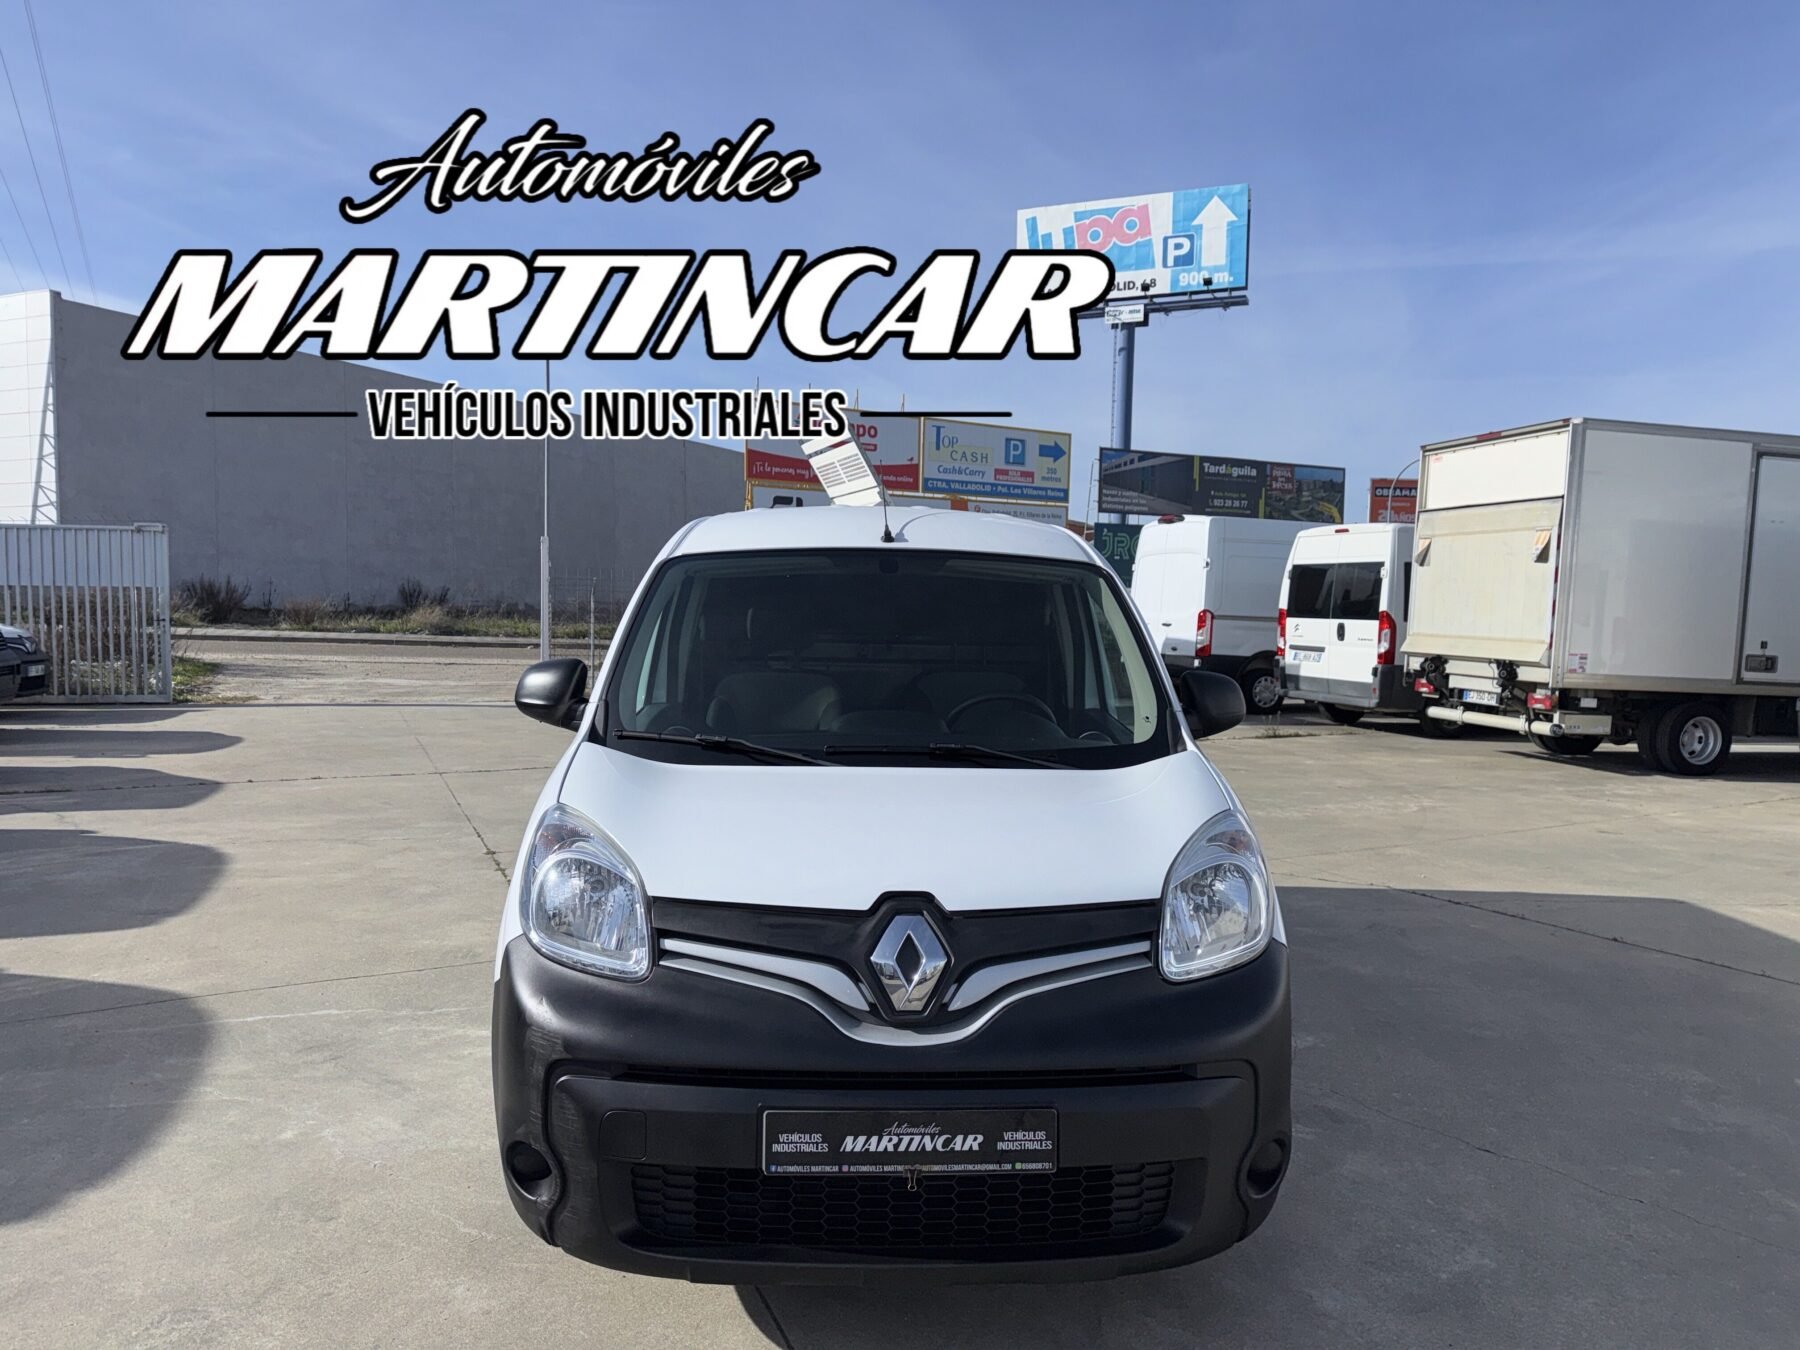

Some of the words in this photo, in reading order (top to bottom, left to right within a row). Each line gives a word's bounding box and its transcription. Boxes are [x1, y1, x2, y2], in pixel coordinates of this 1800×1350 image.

[1166, 237, 1191, 266] P
[950, 449, 989, 464] CASH
[1009, 440, 1023, 463] P
[937, 464, 986, 479] Cash&Carry
[1203, 463, 1257, 477] Tardáguila
[928, 480, 949, 489] CTRA.
[950, 481, 992, 492] VALLADOLID
[1375, 488, 1417, 496] OBRAMA
[881, 1121, 941, 1136] Automóviles
[1003, 1129, 1046, 1140] VEHÍCULOS
[779, 1132, 822, 1143] VEHÍCULOS
[840, 1134, 984, 1152] MARTINCAR
[772, 1143, 829, 1152] INDUSTRIALES
[997, 1140, 1052, 1150] INDUSTRIALES
[777, 1164, 810, 1172] AUTOMÓVILES
[850, 1164, 882, 1172] AUTOMÓVILES
